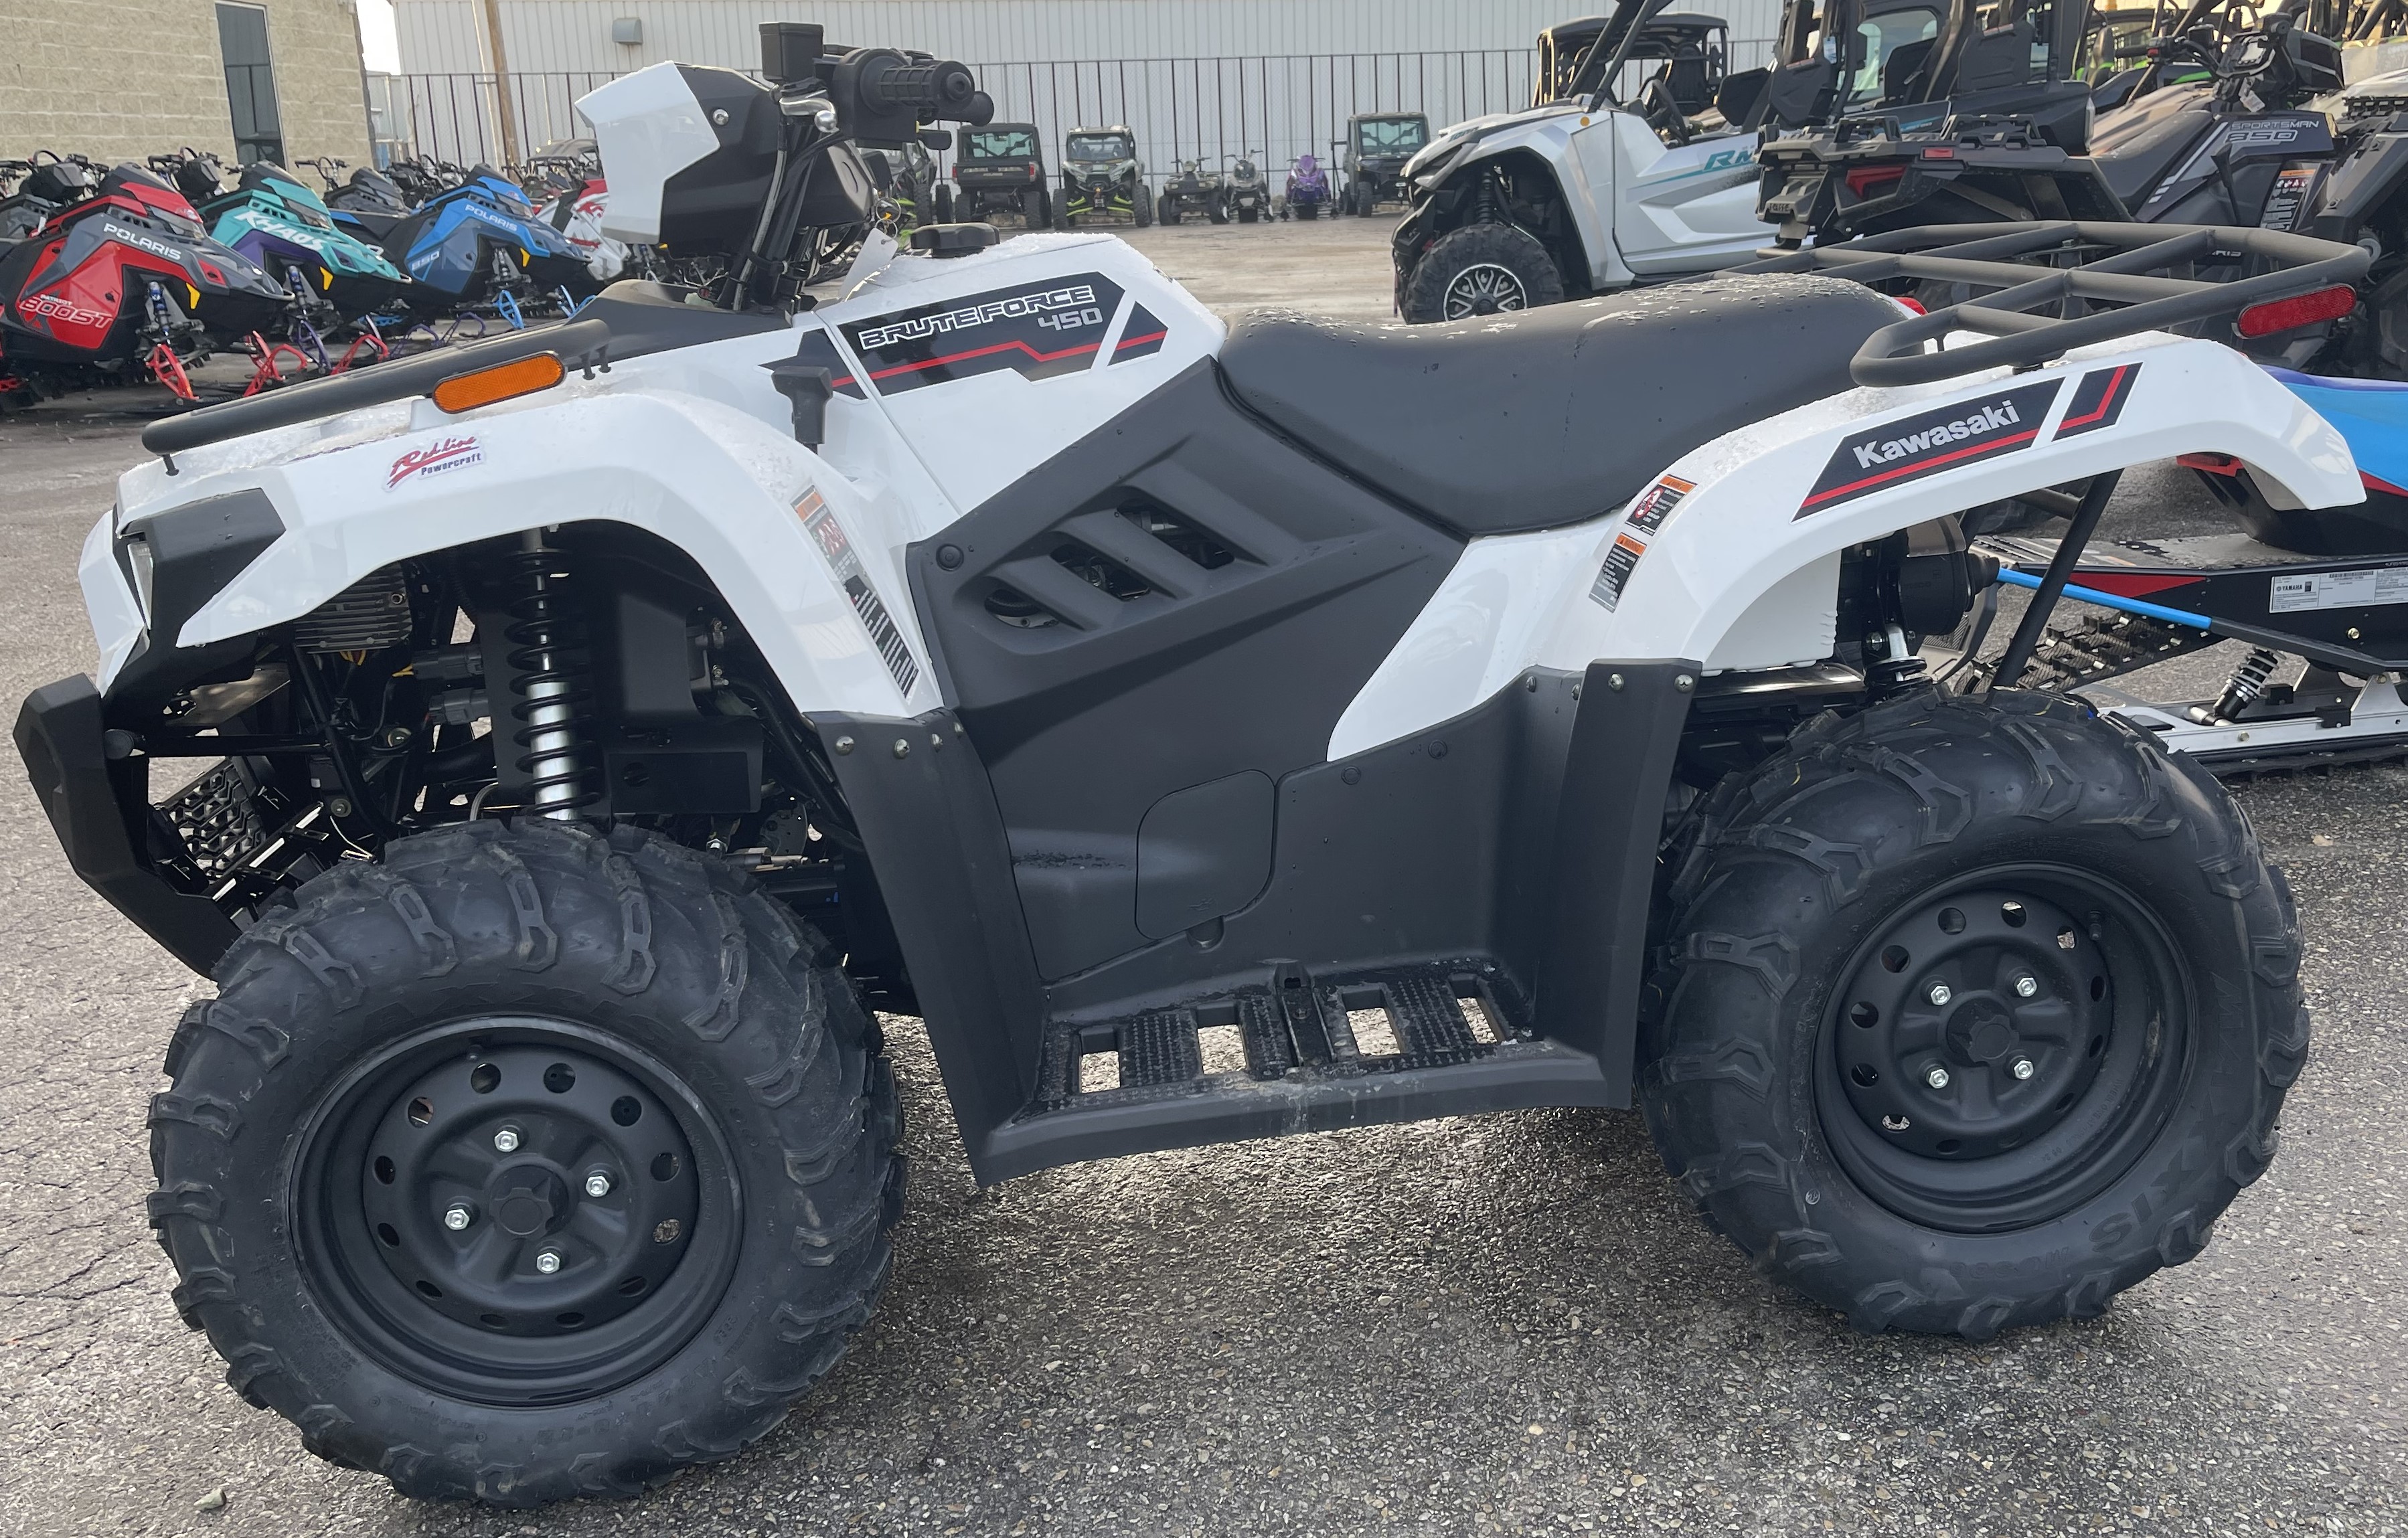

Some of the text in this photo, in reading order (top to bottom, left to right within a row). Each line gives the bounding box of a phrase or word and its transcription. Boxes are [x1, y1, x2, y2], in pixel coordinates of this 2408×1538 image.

[2224, 130, 2298, 144] 850
[2231, 120, 2319, 131] SPORTSMAN
[234, 210, 323, 251] KHAOS
[465, 203, 517, 232] POLARIS
[104, 222, 181, 261] POLARIS
[19, 296, 114, 329] BOOST
[1037, 307, 1103, 331] 450
[1852, 400, 2021, 469] Kawasaki
[421, 452, 481, 476] Powercraft
